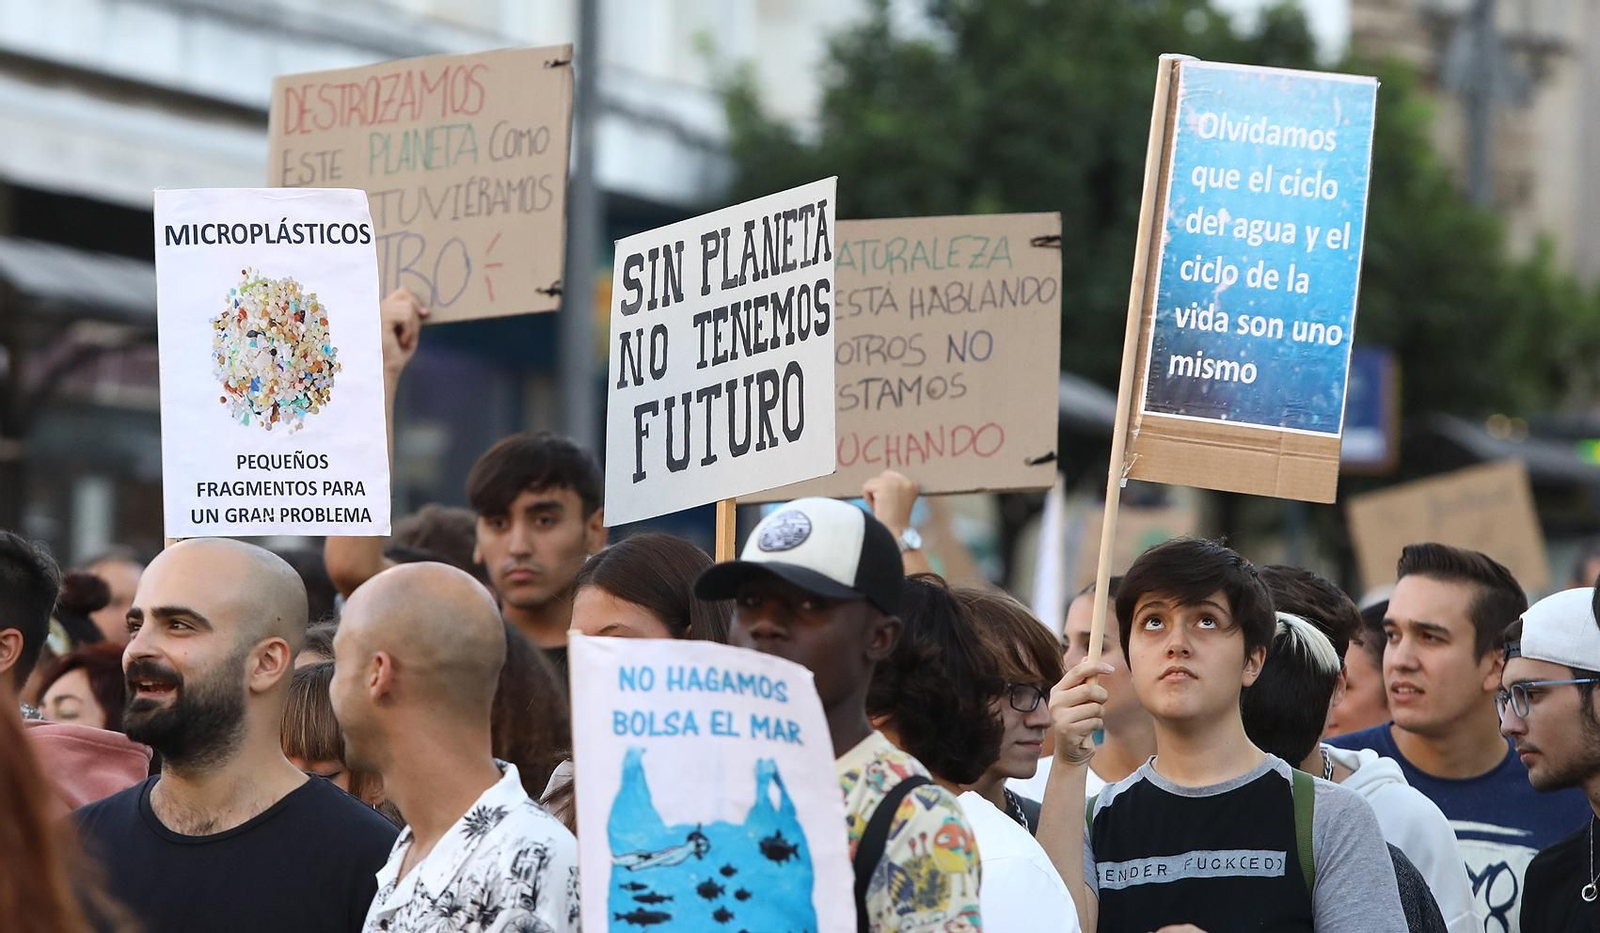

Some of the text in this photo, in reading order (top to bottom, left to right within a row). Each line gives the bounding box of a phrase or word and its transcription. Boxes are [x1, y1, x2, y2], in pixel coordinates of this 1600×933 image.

[283, 64, 490, 135] DESTROZAMOS
[1198, 111, 1337, 152] Olvidamos
[281, 148, 343, 187] ESTE
[367, 123, 478, 176] PLANETA
[369, 174, 554, 230] TUVIÉRAMOS
[1191, 164, 1339, 200] que el ciclo
[164, 217, 371, 246] MICROPLÁSTICOS
[1186, 206, 1351, 253] del agua y el
[376, 230, 472, 307] TRO
[620, 198, 832, 317] SIN PLANETA
[835, 234, 1013, 276] ATURALEZA
[1180, 254, 1310, 294] ciclo de la
[909, 275, 1058, 320] HABLANDO
[616, 278, 831, 390] NO TENEMOS
[1174, 301, 1343, 346] vida son uno
[835, 330, 994, 367] OTROS NO
[1168, 350, 1258, 384] mismo
[836, 372, 967, 411] STAMOS
[632, 360, 804, 484] FUTURO
[236, 450, 329, 472] PEQUEÑOS
[836, 422, 1005, 468] UCHANDO
[196, 480, 366, 497] FRAGMENTOS PARA
[191, 507, 372, 524] UN GRAN PROBLEMA
[619, 665, 790, 704] NO HAGAMOS
[612, 709, 804, 746] BOLSA EL MAR
[1097, 856, 1283, 882] ENDER FUCK(ED)
